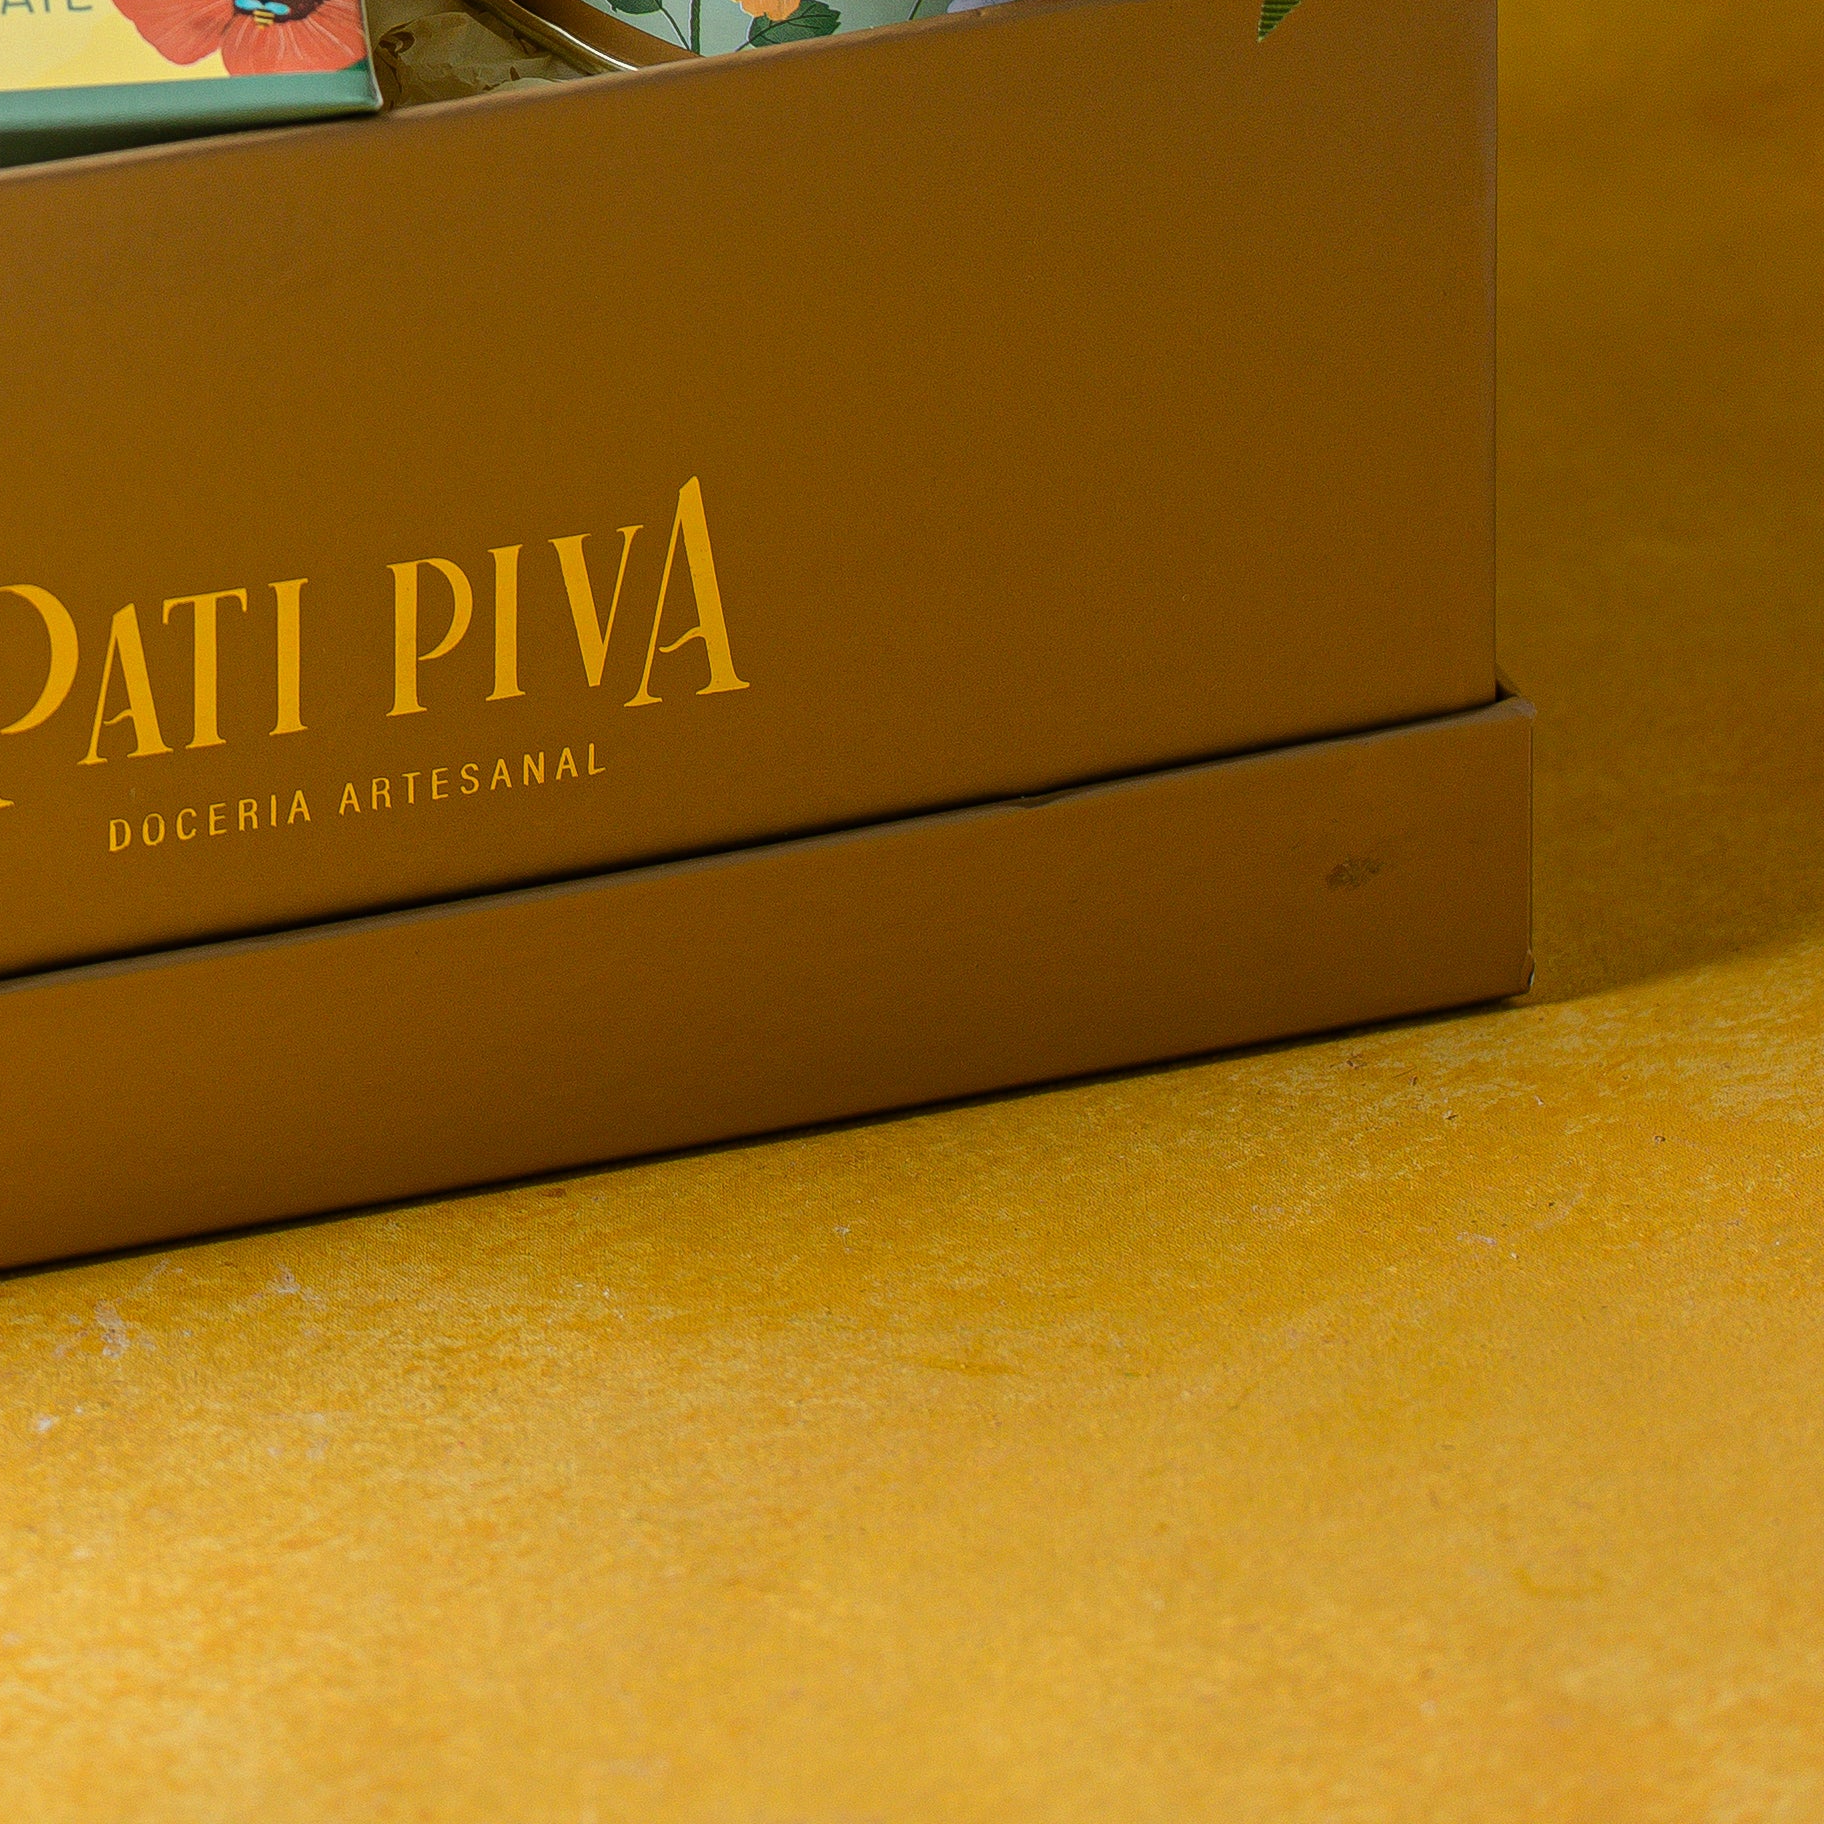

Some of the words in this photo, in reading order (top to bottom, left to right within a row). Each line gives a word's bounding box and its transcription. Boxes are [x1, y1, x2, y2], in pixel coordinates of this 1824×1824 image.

[385, 474, 750, 716] PIVA
[107, 788, 313, 853] DOCERIA
[337, 742, 607, 818] ARTESANAL
